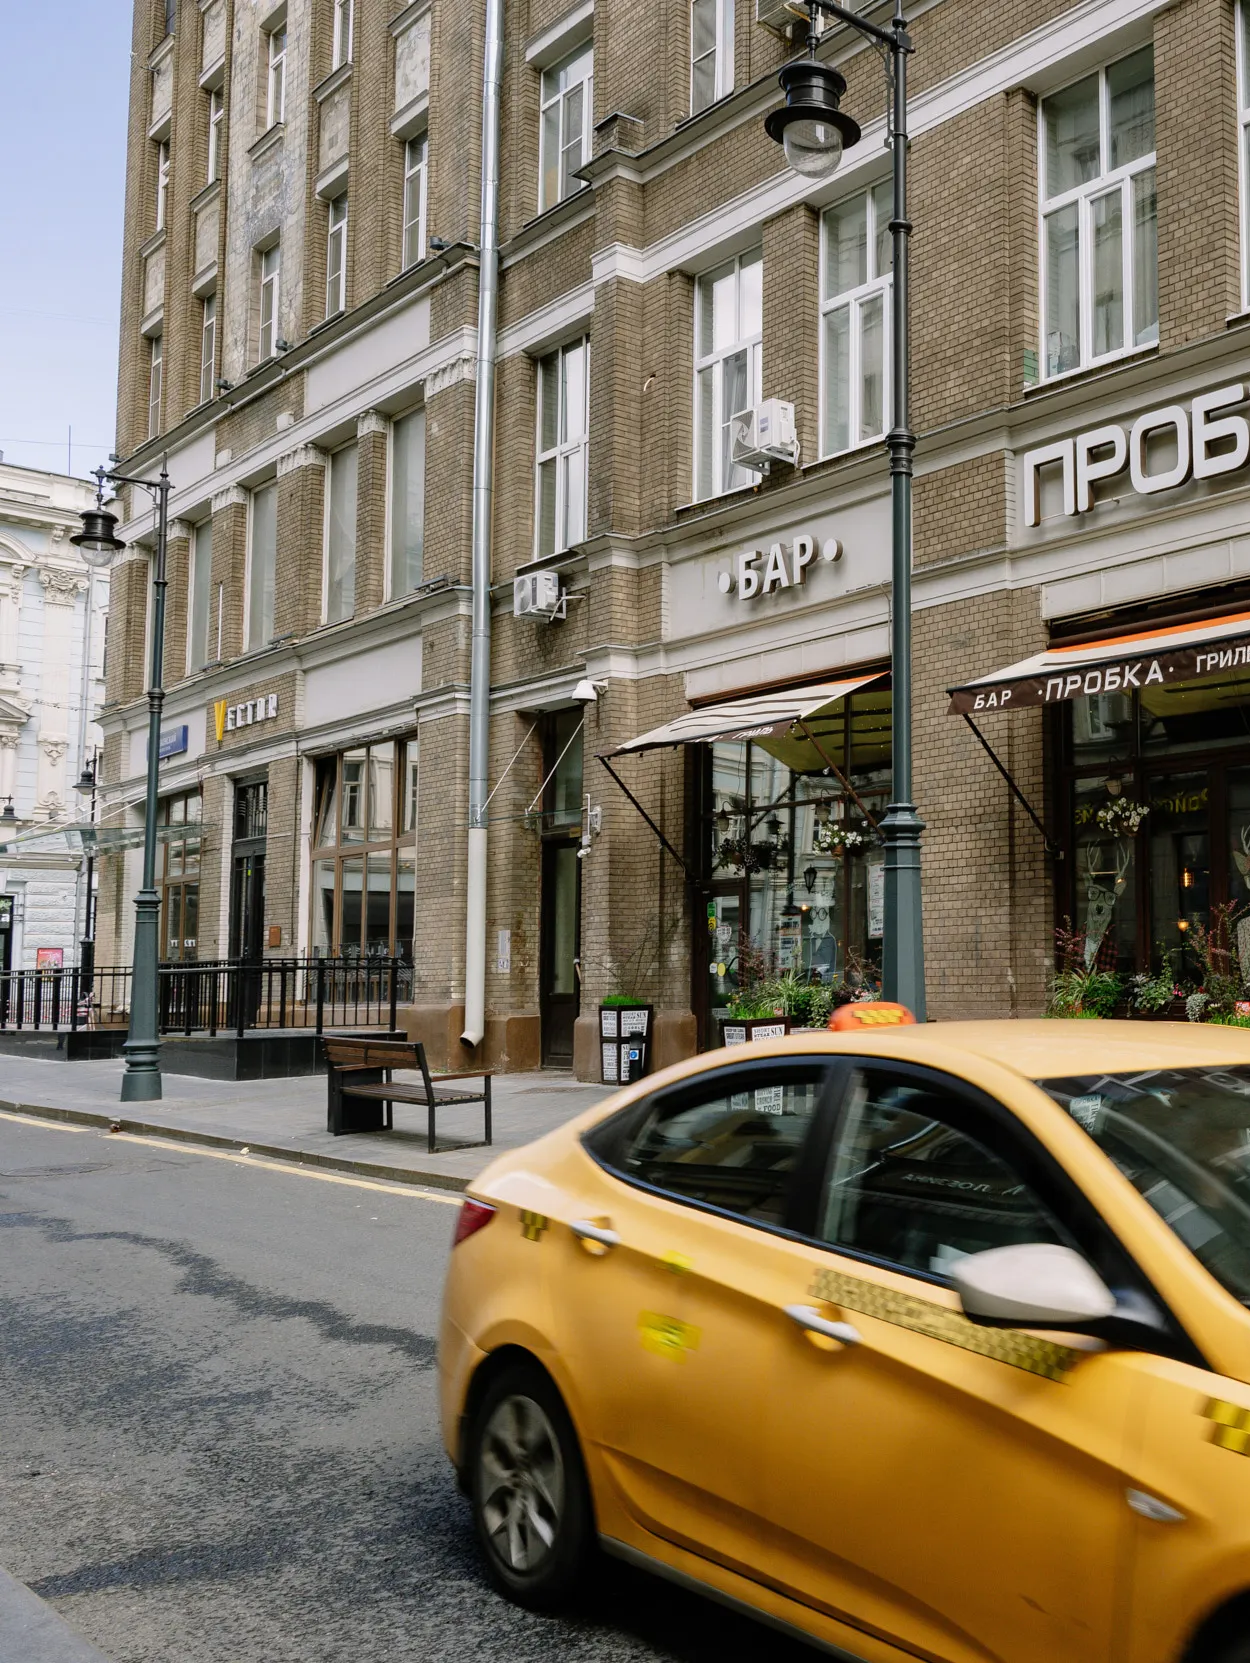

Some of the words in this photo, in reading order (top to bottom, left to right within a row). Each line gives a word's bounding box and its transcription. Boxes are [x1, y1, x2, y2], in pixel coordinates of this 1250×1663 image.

[739, 534, 819, 600] БАР
[973, 689, 1012, 710] БАР
[1045, 660, 1164, 701] ПРОБКА
